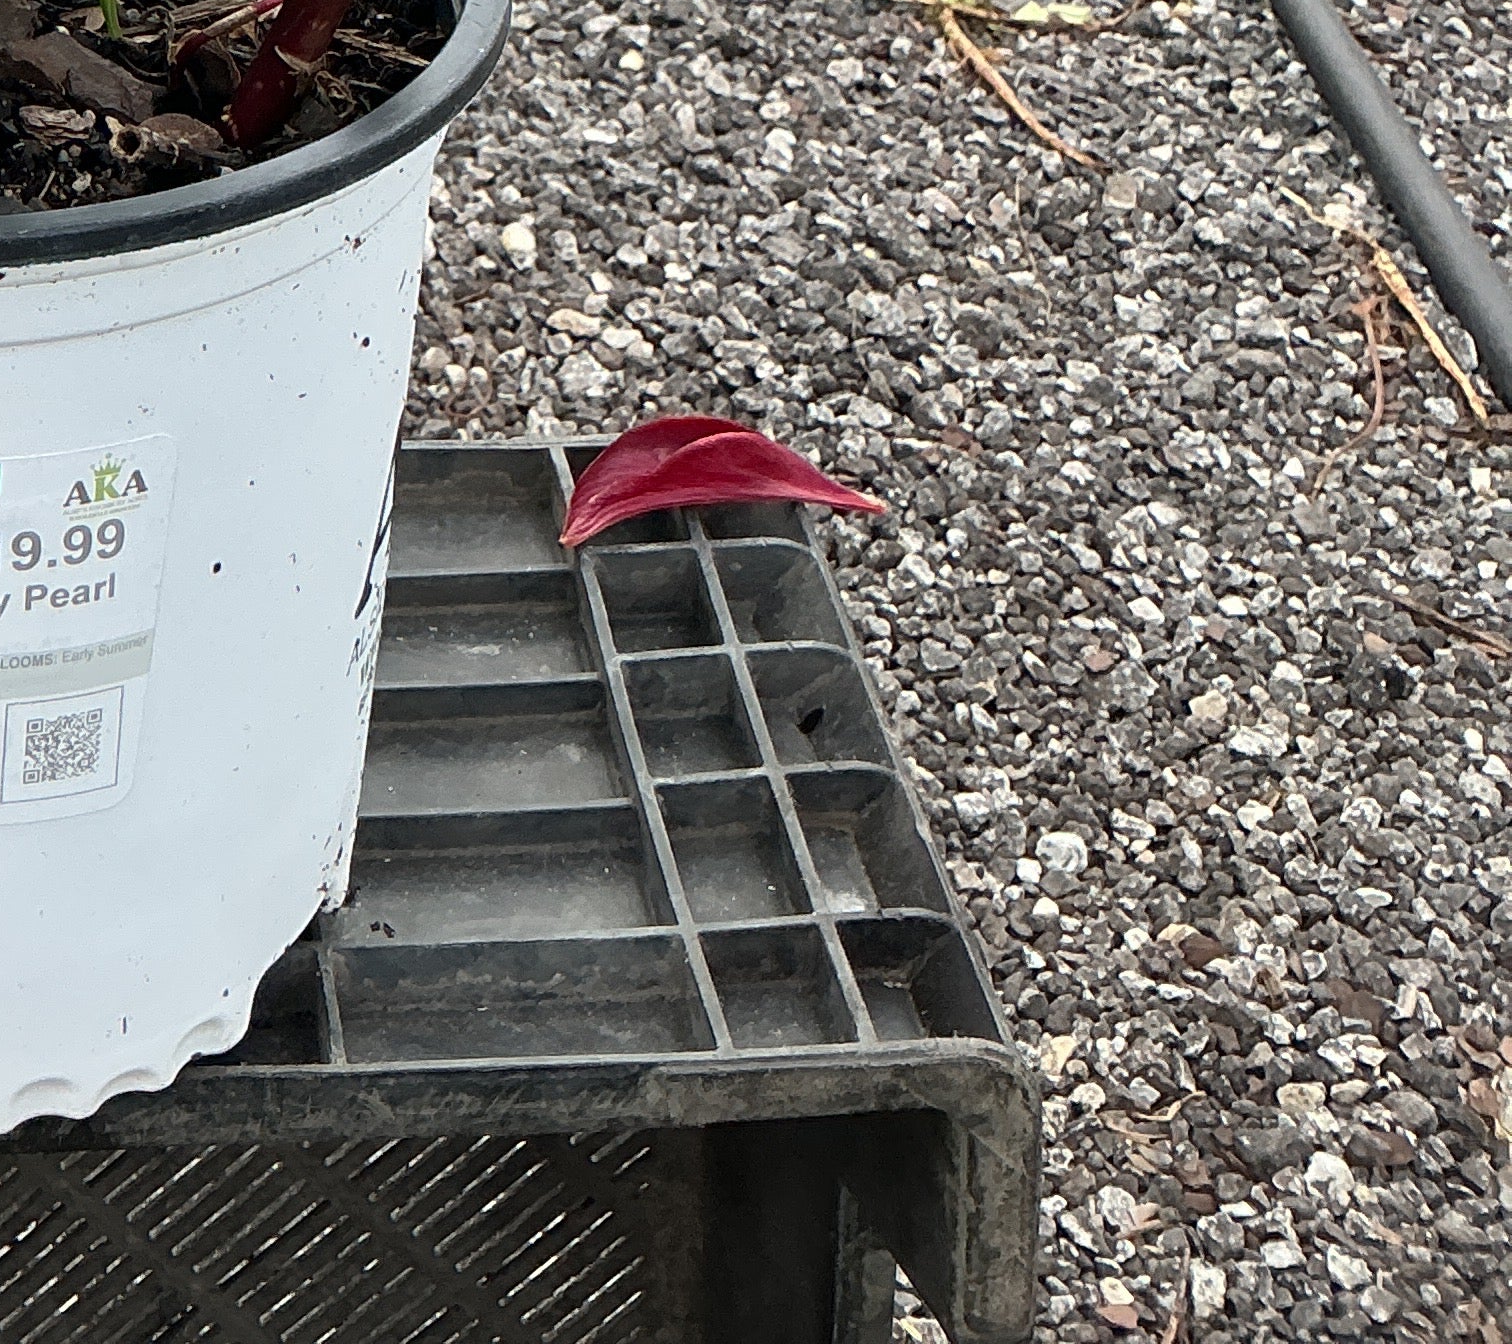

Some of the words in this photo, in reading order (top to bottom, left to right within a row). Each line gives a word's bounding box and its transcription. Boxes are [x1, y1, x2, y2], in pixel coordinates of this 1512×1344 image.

[63, 468, 148, 508] AKA
[24, 572, 117, 612] Pearl
[62, 648, 94, 663] Early
[97, 634, 148, 657] Summer
